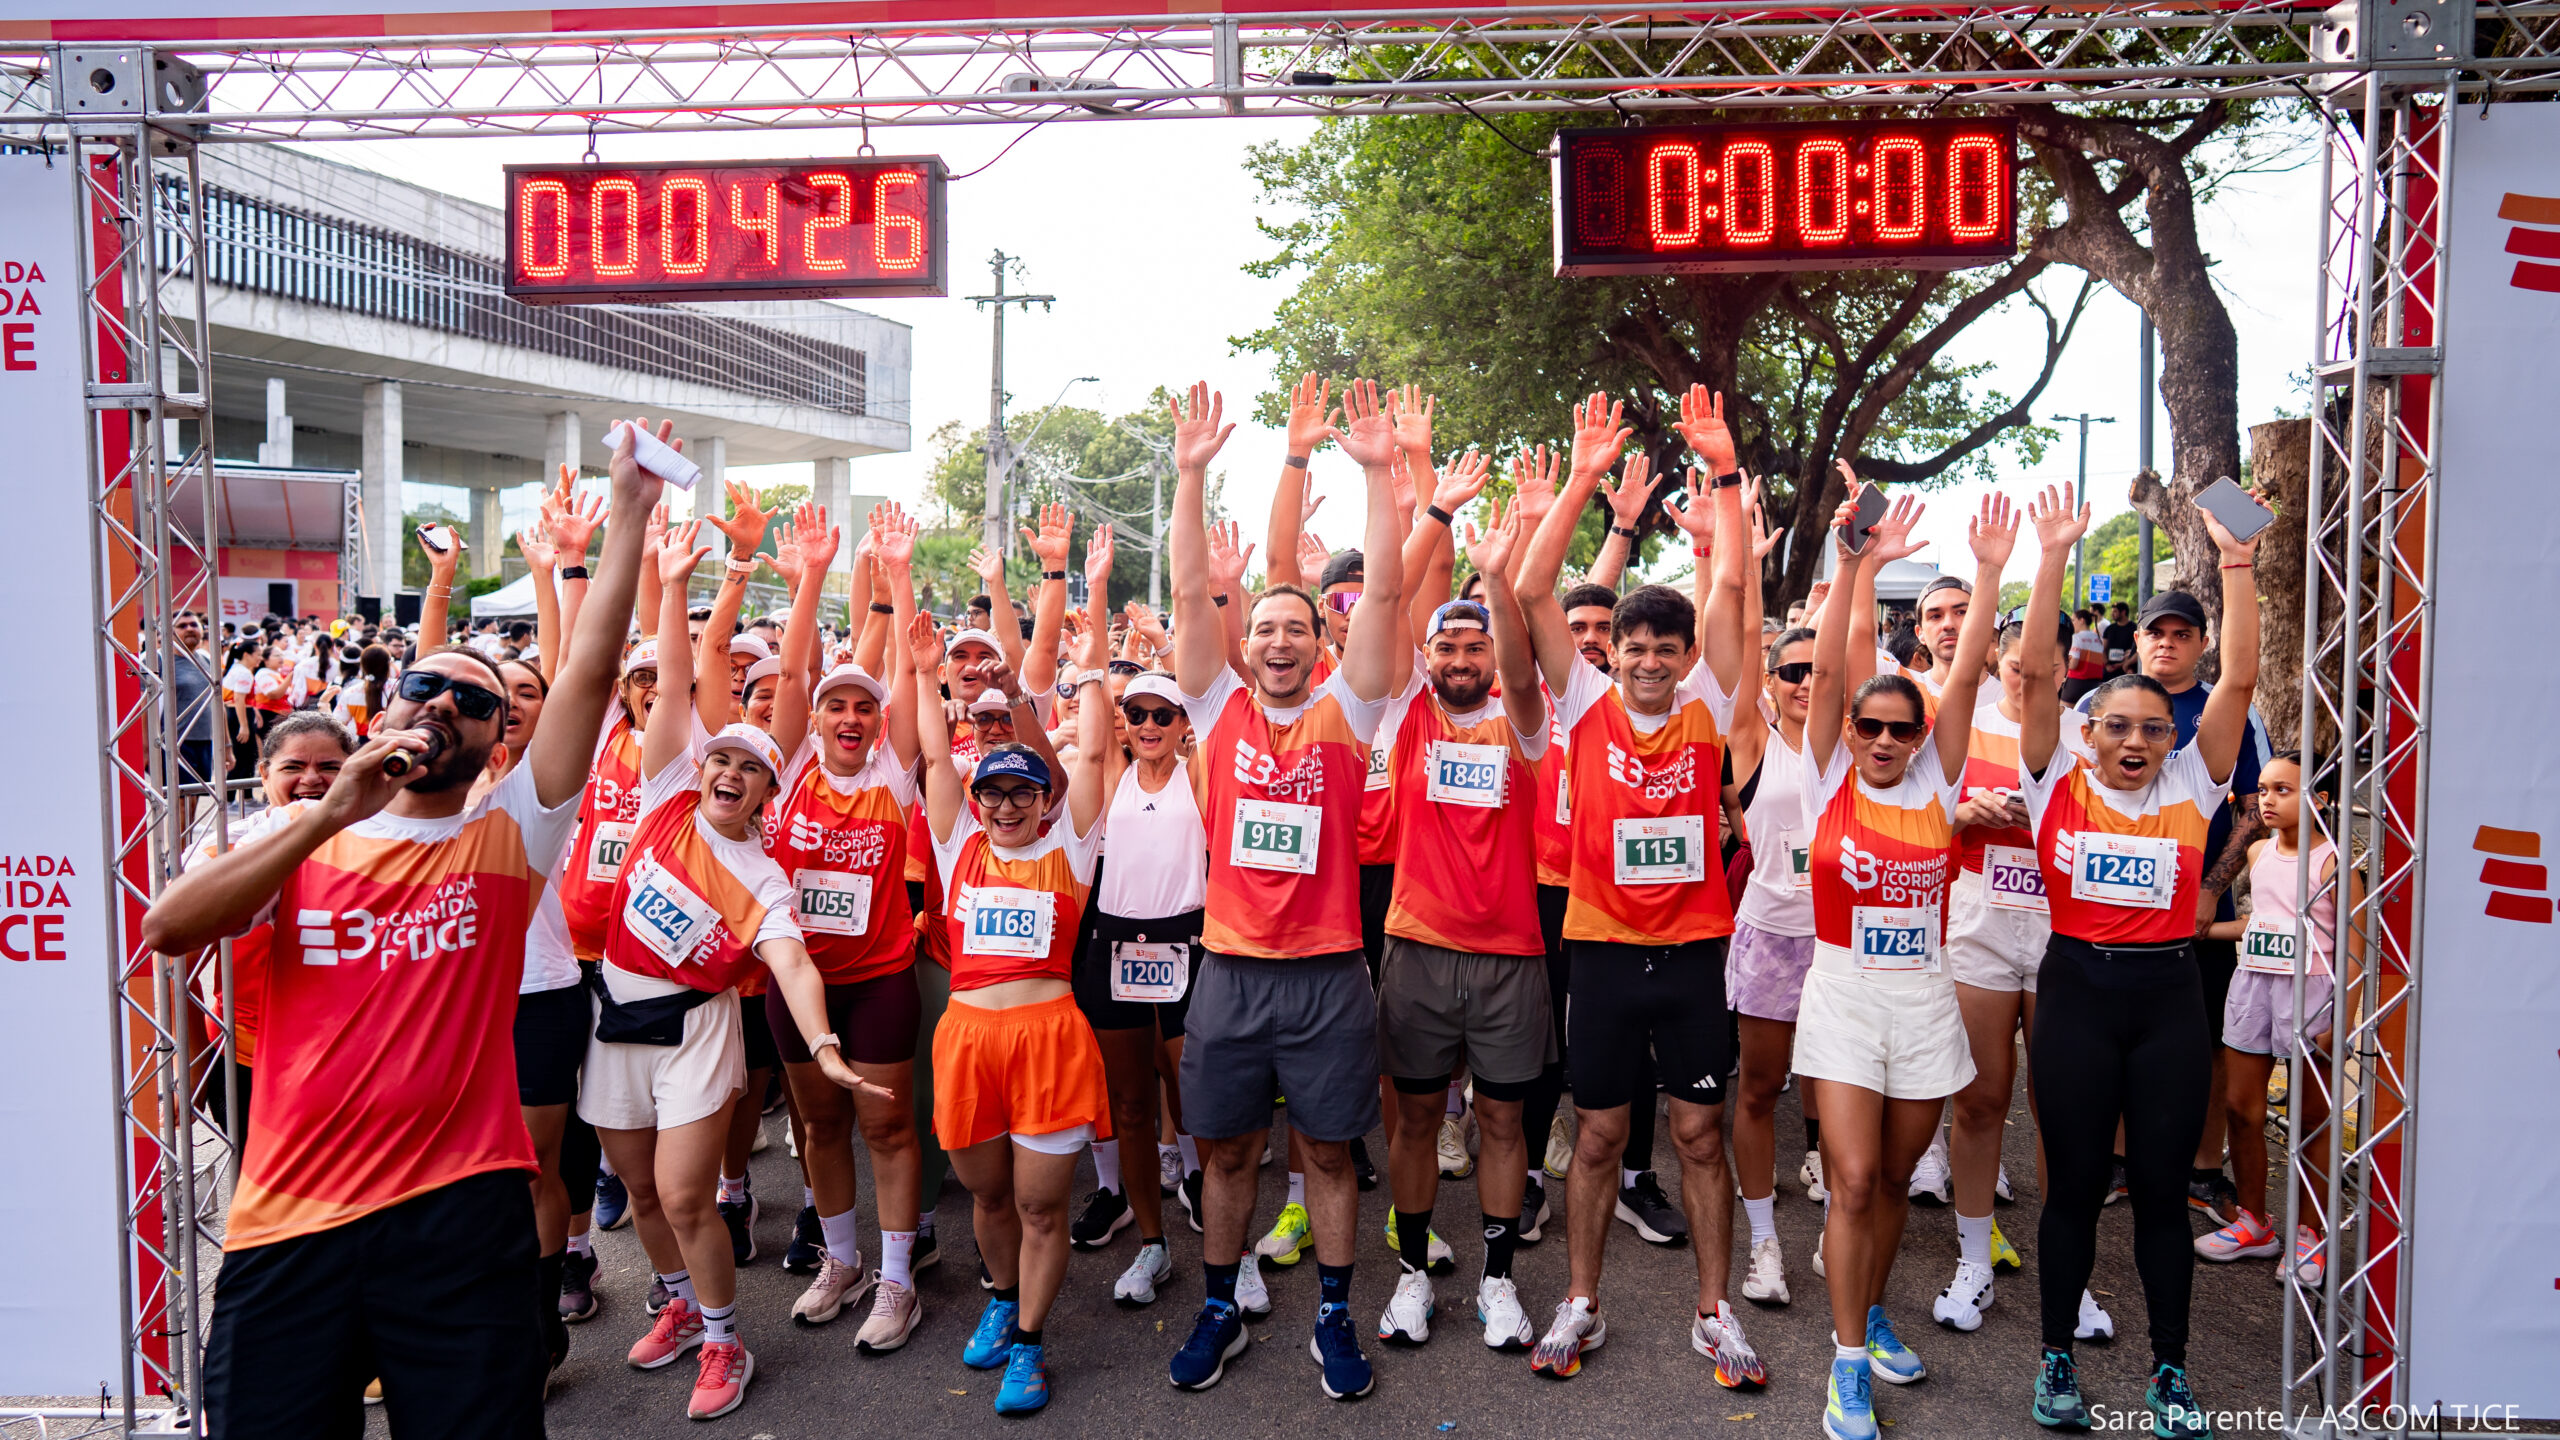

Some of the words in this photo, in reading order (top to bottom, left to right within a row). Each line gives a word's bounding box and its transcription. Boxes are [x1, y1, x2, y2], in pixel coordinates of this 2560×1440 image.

[0, 261, 46, 283] DA
[1442, 763, 1494, 788] 1849
[1269, 783, 1292, 796] DO
[1645, 785, 1669, 799] DO
[1251, 823, 1293, 850] 913
[601, 841, 627, 865] 10
[824, 848, 846, 863] DO
[848, 846, 884, 870] TJCE
[1635, 838, 1679, 864] 115
[1882, 866, 1947, 888] /CORRIDA
[2089, 855, 2154, 885] 1248
[0, 880, 71, 908] IDA
[802, 890, 853, 916] 1055
[1882, 885, 1907, 903] DO
[637, 889, 692, 939] 1844
[978, 909, 1034, 936] 1168
[1866, 929, 1925, 954] 1784
[2249, 933, 2295, 957] 1140
[1123, 962, 1173, 984] 1200
